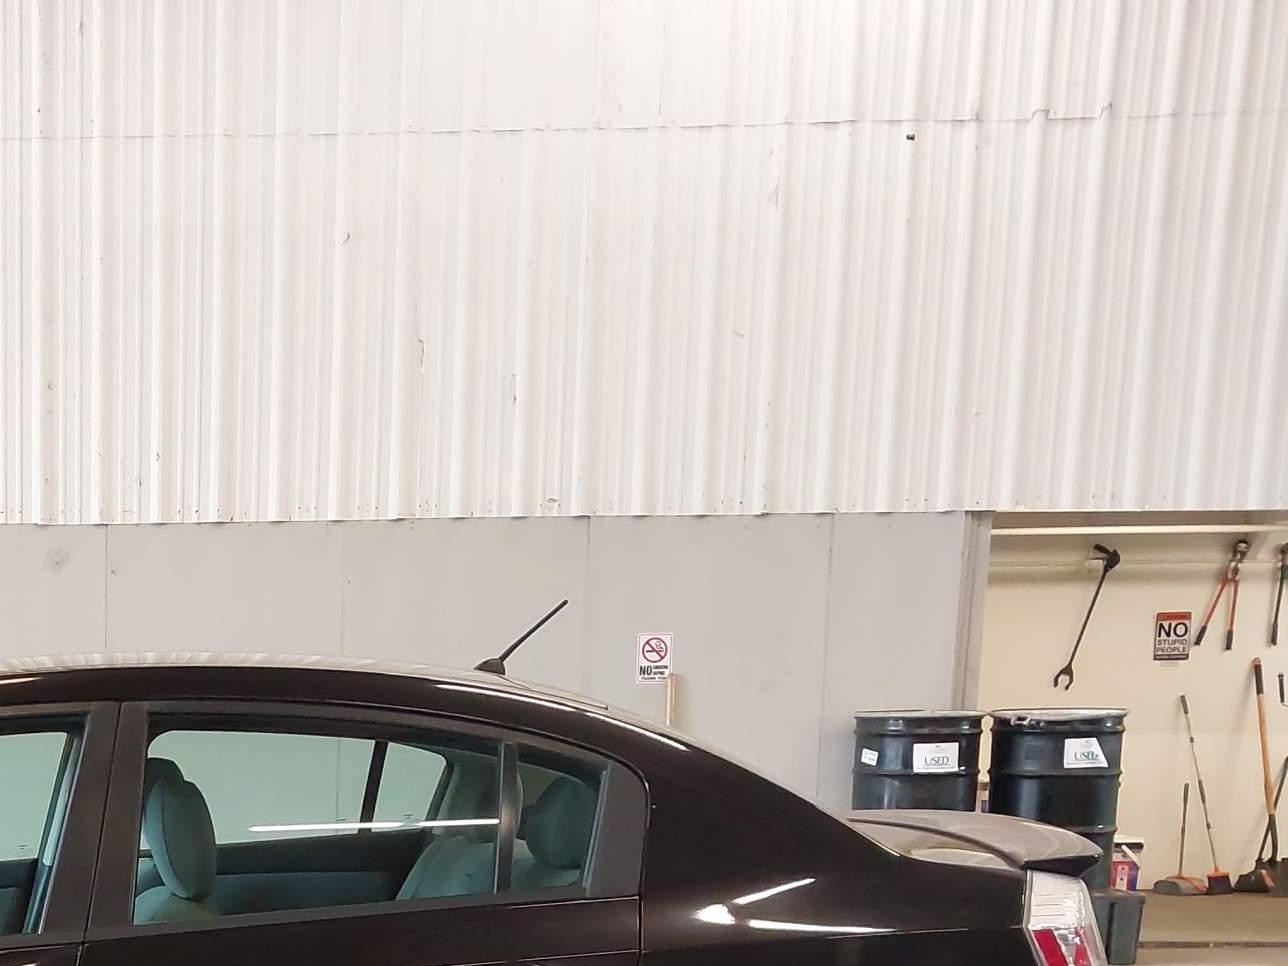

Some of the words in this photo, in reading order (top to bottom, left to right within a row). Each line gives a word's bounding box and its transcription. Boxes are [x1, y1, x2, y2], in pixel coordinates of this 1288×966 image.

[1158, 622, 1188, 638] NO
[639, 665, 652, 676] NO
[924, 756, 950, 765] USED
